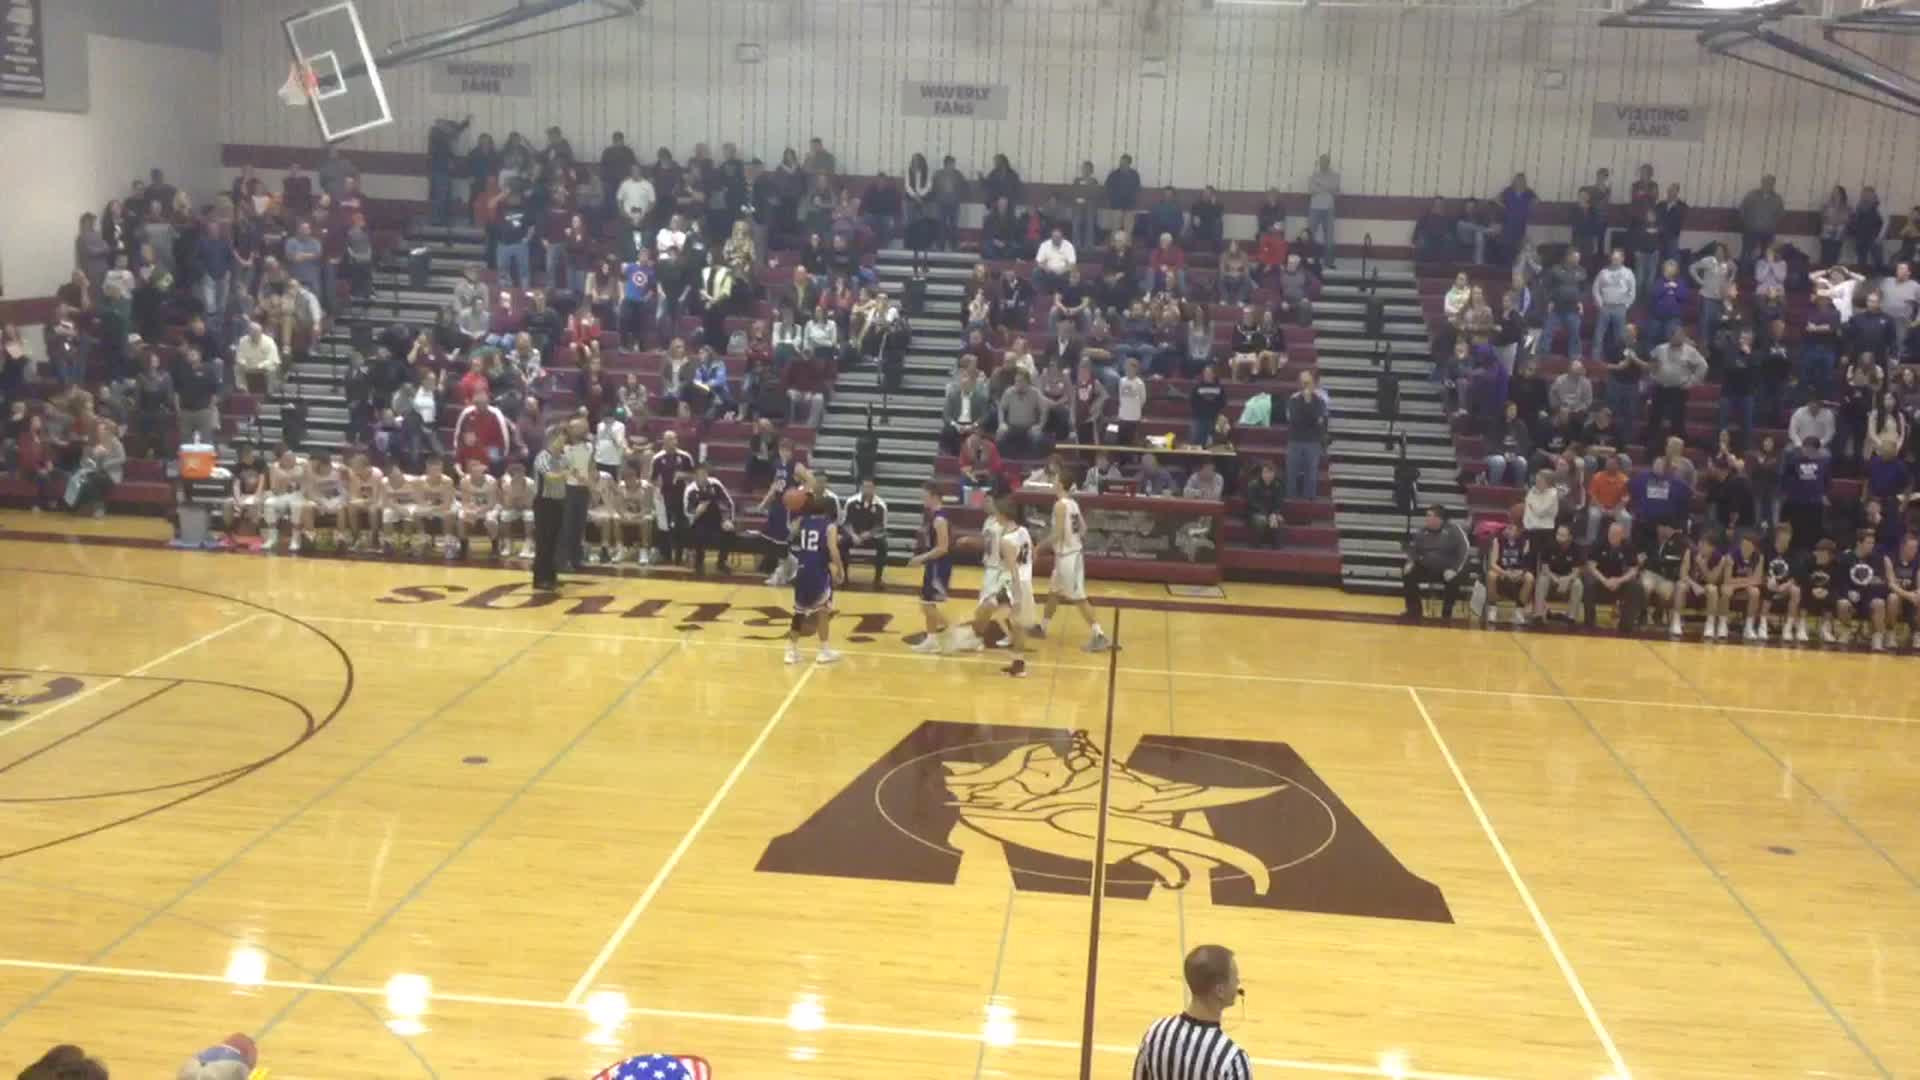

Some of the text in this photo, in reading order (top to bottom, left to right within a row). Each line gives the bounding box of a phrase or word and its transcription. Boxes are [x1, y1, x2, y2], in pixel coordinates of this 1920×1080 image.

[920, 84, 991, 100] WAVERLY
[935, 100, 975, 115] FANS
[1616, 105, 1688, 122] VISITING
[1628, 121, 1672, 137] FANS
[800, 529, 820, 551] 12
